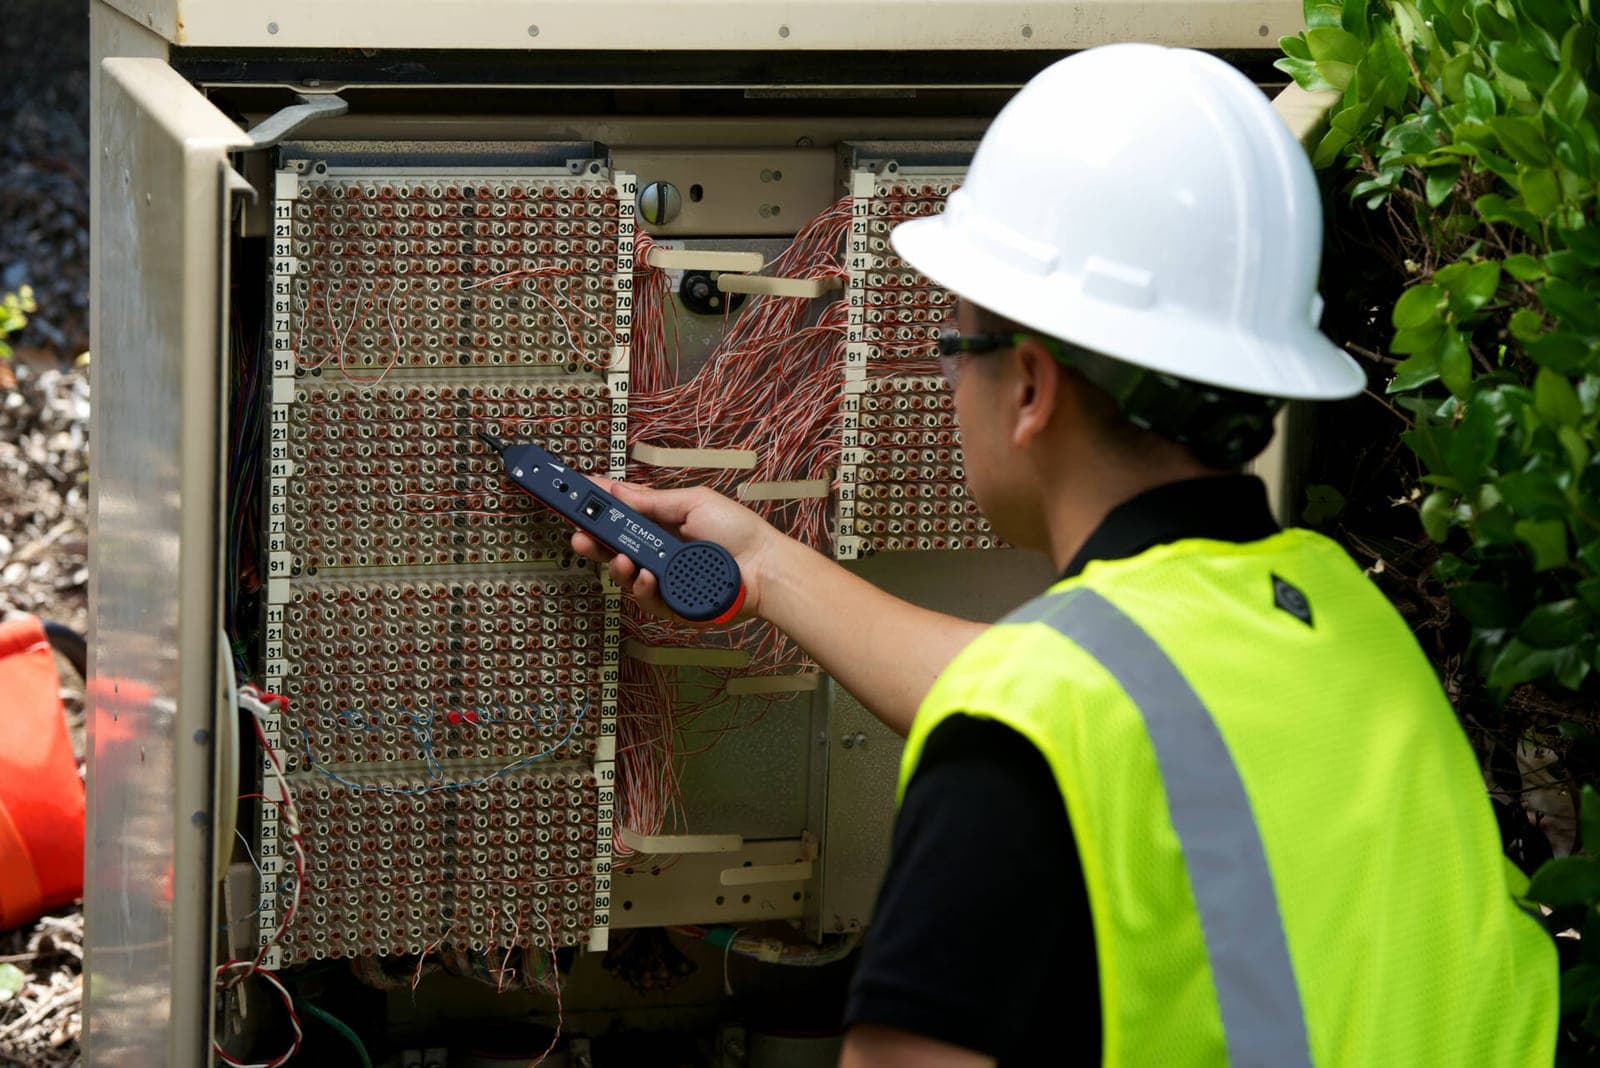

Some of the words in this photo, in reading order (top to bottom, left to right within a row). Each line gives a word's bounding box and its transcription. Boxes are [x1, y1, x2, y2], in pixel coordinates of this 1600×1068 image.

[623, 183, 636, 193] 10
[277, 207, 289, 217] 11
[621, 205, 635, 215] 20
[855, 205, 866, 214] 11
[277, 225, 289, 235] 21
[619, 223, 633, 233] 30
[854, 223, 865, 233] 21
[277, 245, 289, 255] 31
[619, 242, 632, 251] 40
[854, 241, 865, 251] 31
[619, 259, 632, 268] 50
[853, 258, 864, 267] 41
[276, 263, 289, 272] 41
[618, 279, 631, 289] 60
[852, 279, 864, 288] 51
[277, 284, 290, 293] 51
[276, 300, 289, 310] 61
[618, 297, 631, 307] 70
[851, 297, 864, 306] 61
[617, 315, 630, 325] 80
[851, 314, 863, 323] 71
[276, 320, 289, 329] 71
[850, 332, 862, 341] 81
[276, 339, 288, 349] 81
[849, 352, 861, 361] 91
[275, 360, 288, 370] 91
[615, 382, 627, 391] 10
[614, 404, 626, 413] 20
[846, 400, 857, 410] 11
[272, 411, 285, 420] 11
[613, 422, 626, 431] 30
[845, 418, 856, 427] 21
[273, 429, 285, 439] 21
[844, 435, 856, 444] 31
[612, 440, 625, 449] 40
[273, 448, 285, 457] 31
[612, 457, 624, 466] 50
[843, 453, 855, 462] 41
[273, 465, 285, 475] 41
[843, 472, 855, 482] 51
[273, 486, 286, 496] 51
[842, 490, 855, 499] 61
[272, 504, 285, 514] 61
[842, 507, 854, 516] 71
[272, 522, 284, 532] 71
[841, 525, 853, 533] 81
[625, 518, 663, 547] TEMPO
[271, 539, 284, 549] 81
[840, 545, 852, 554] 91
[271, 561, 283, 571] 91
[607, 600, 620, 609] 20
[269, 611, 281, 621] 11
[606, 618, 619, 627] 30
[269, 629, 281, 639] 21
[605, 635, 619, 644] 40
[269, 648, 281, 657] 31
[604, 652, 617, 661] 50
[268, 665, 280, 674] 41
[604, 672, 617, 681] 60
[268, 686, 281, 694] 51
[603, 689, 616, 698] 70
[603, 706, 616, 715] 80
[267, 721, 279, 731] 71
[602, 724, 615, 733] 90
[601, 770, 613, 780] 10
[600, 792, 612, 801] 20
[263, 809, 275, 818] 11
[599, 810, 612, 819] 30
[263, 827, 275, 836] 21
[598, 827, 611, 836] 40
[263, 845, 275, 855] 31
[598, 843, 611, 853] 50
[263, 862, 275, 871] 41
[597, 862, 610, 872] 60
[597, 880, 610, 889] 70
[596, 897, 609, 906] 80
[262, 917, 275, 927] 71
[595, 915, 608, 924] 90
